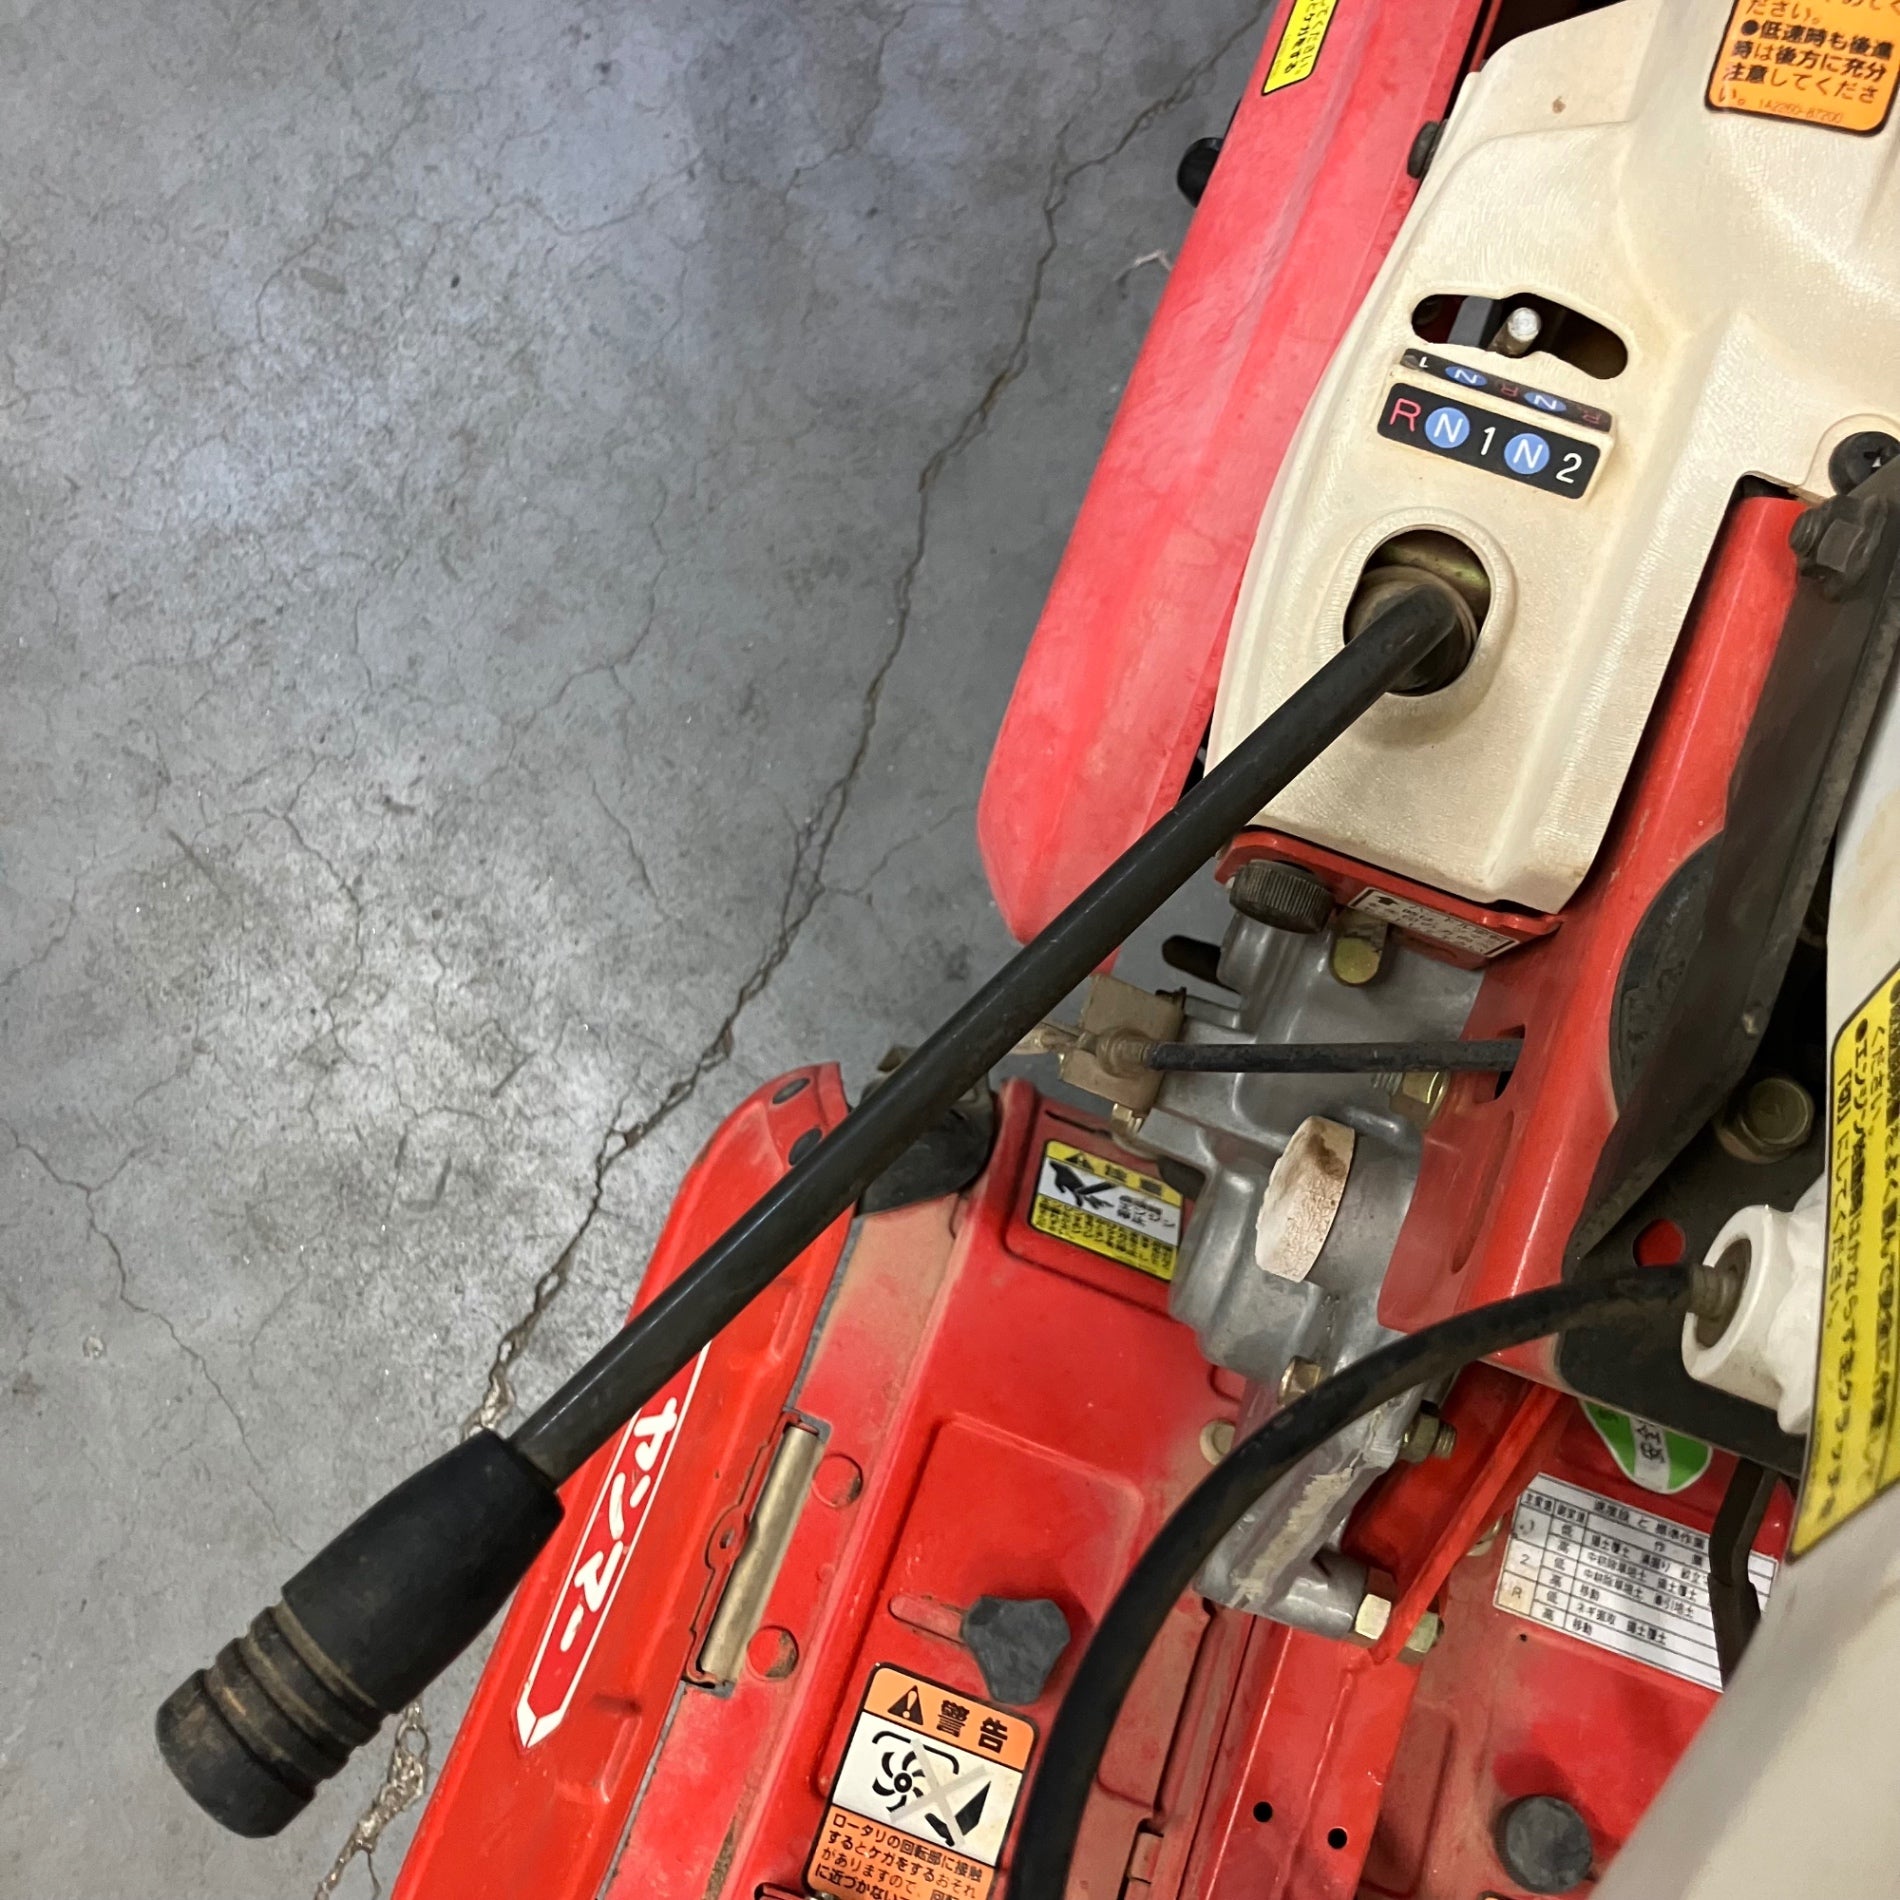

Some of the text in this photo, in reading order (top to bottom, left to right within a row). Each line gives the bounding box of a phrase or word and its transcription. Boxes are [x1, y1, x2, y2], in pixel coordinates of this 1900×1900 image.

[1454, 368, 1477, 384] N
[1534, 395, 1557, 410] N
[1389, 398, 1583, 484] R N 1 N 2
[560, 1397, 677, 1652] ヤンマー
[1520, 1554, 1530, 1566] 2
[1511, 1587, 1522, 1600] R
[936, 1699, 1008, 1754] 警告
[829, 1830, 977, 1900] するとケガをするおそれ
